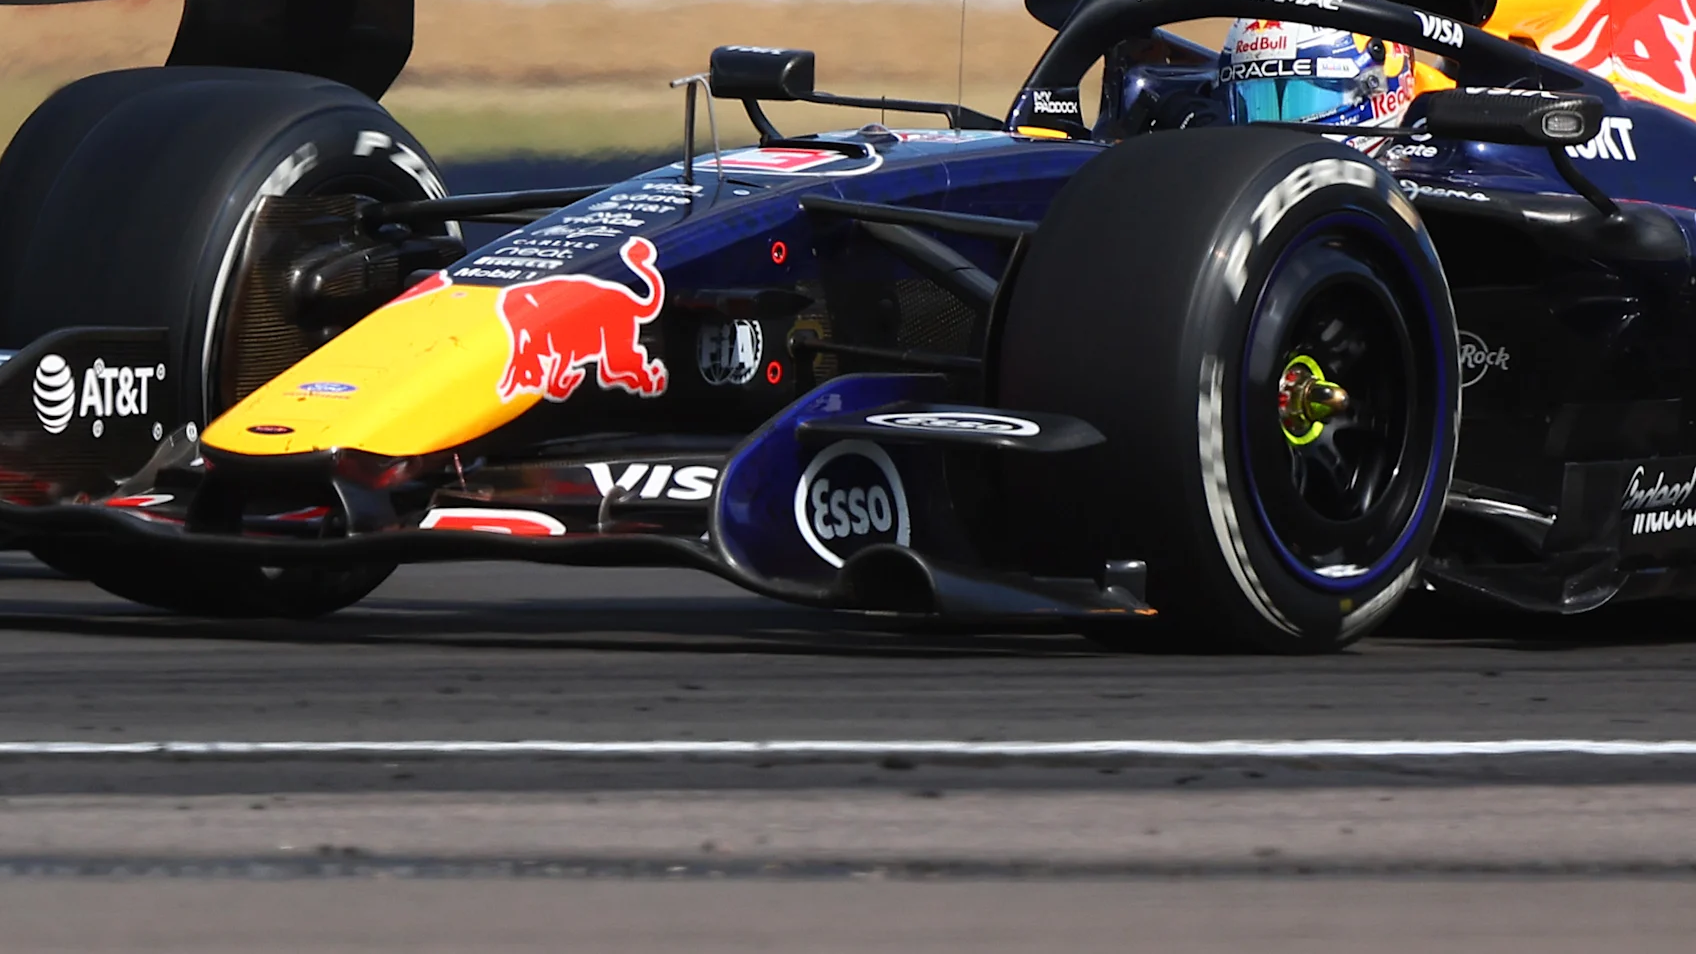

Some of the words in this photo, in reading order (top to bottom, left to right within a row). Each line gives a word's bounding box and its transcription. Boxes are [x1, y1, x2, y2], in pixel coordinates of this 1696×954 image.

[1413, 10, 1464, 48] VISA
[1235, 38, 1260, 54] Red
[1260, 35, 1288, 52] Bull
[1219, 58, 1312, 81] ORACLE
[1033, 90, 1053, 103] MY
[1034, 101, 1078, 114] PADDOCK
[1564, 116, 1637, 162] KT
[512, 238, 600, 250] CARLYLE
[453, 267, 522, 279] Mobil
[1460, 343, 1511, 371] Rock
[79, 367, 154, 417] AT&T
[585, 463, 719, 501] VIS
